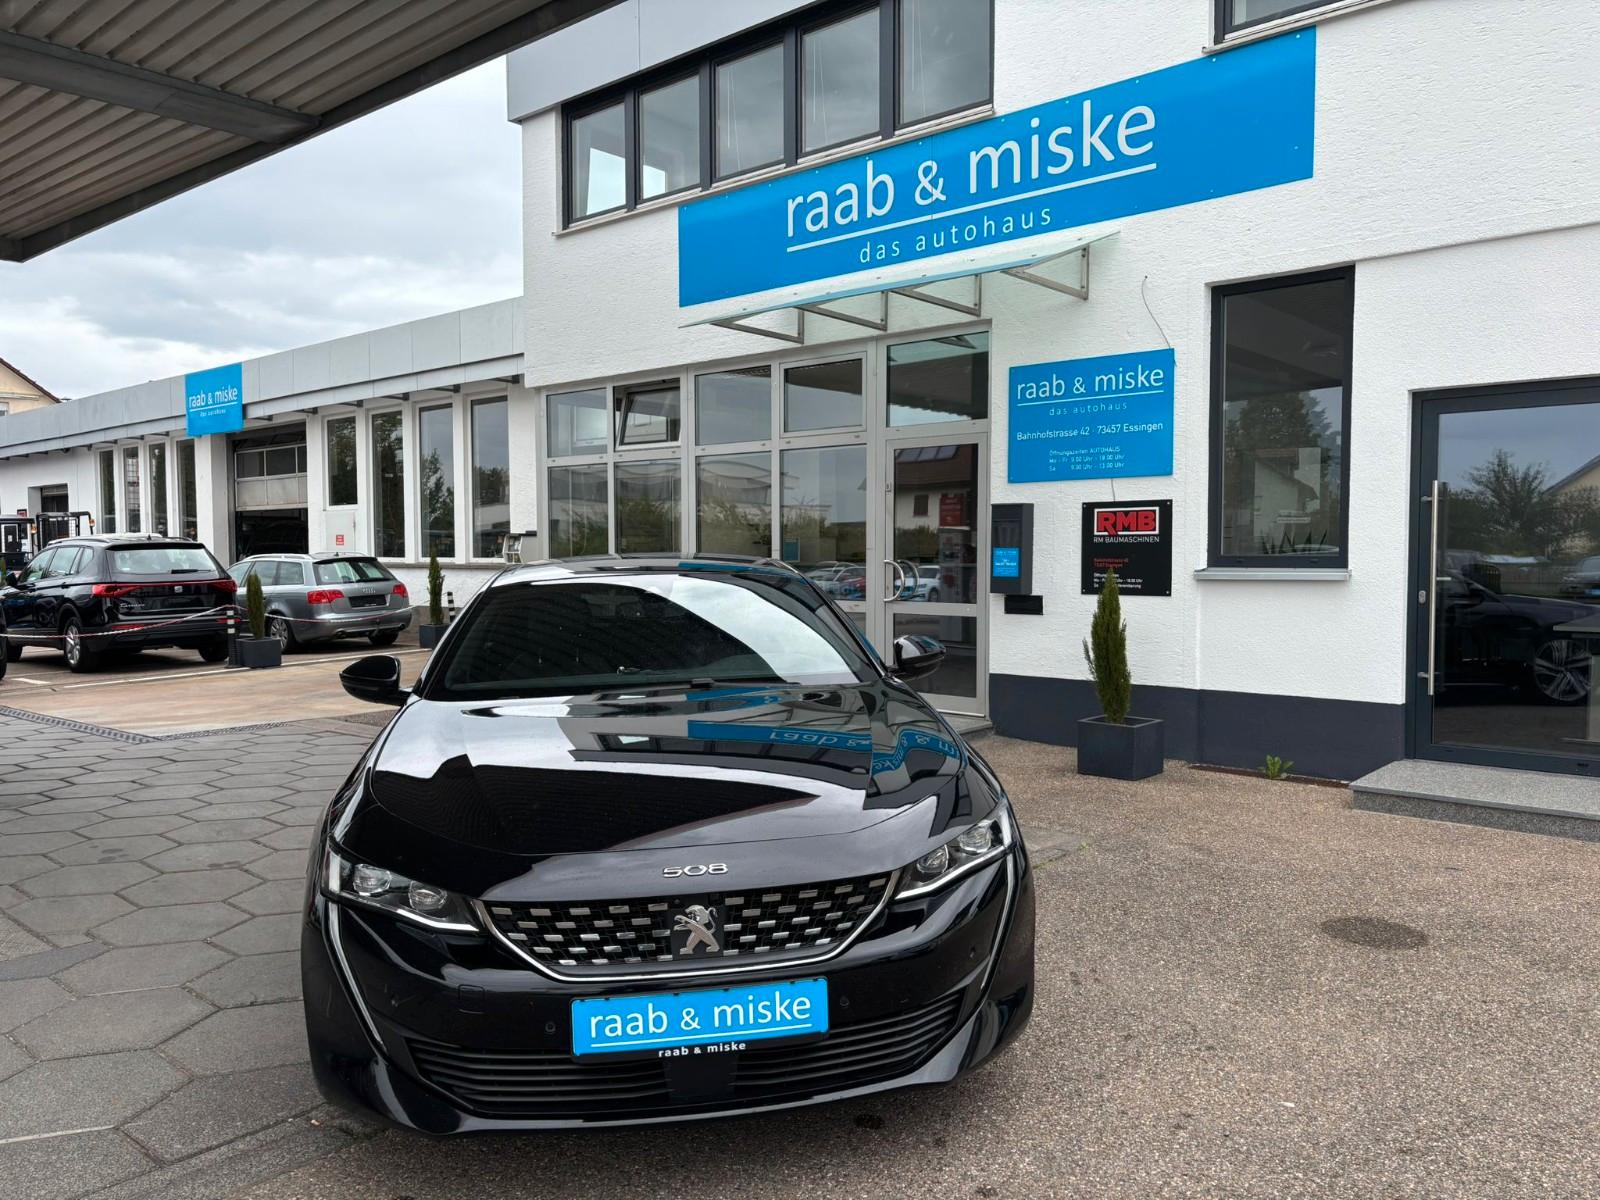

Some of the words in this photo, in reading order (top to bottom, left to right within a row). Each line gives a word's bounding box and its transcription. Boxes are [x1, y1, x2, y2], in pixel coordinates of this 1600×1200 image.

[787, 160, 895, 238] raab
[914, 160, 947, 206] &
[969, 99, 1156, 194] miske
[860, 241, 900, 263] das
[915, 208, 1051, 251] autohaus
[1016, 374, 1065, 400] raab
[1073, 376, 1086, 394] &
[1095, 364, 1164, 392] miske
[189, 390, 206, 408] raab
[208, 393, 213, 404] &
[215, 385, 238, 404] miske
[1072, 402, 1128, 414] autohaus
[1017, 428, 1078, 441] Bahnhofstrasse
[1080, 427, 1090, 436] 42
[1097, 424, 1121, 434] 73457
[1123, 422, 1164, 433] Essingen
[1097, 511, 1156, 536] RMB
[663, 863, 728, 877] 508
[591, 1003, 668, 1038] raab
[680, 1007, 701, 1030] &
[713, 991, 811, 1027] miske
[658, 1046, 689, 1057] raab
[694, 1046, 702, 1054] &
[707, 1041, 746, 1053] miske
